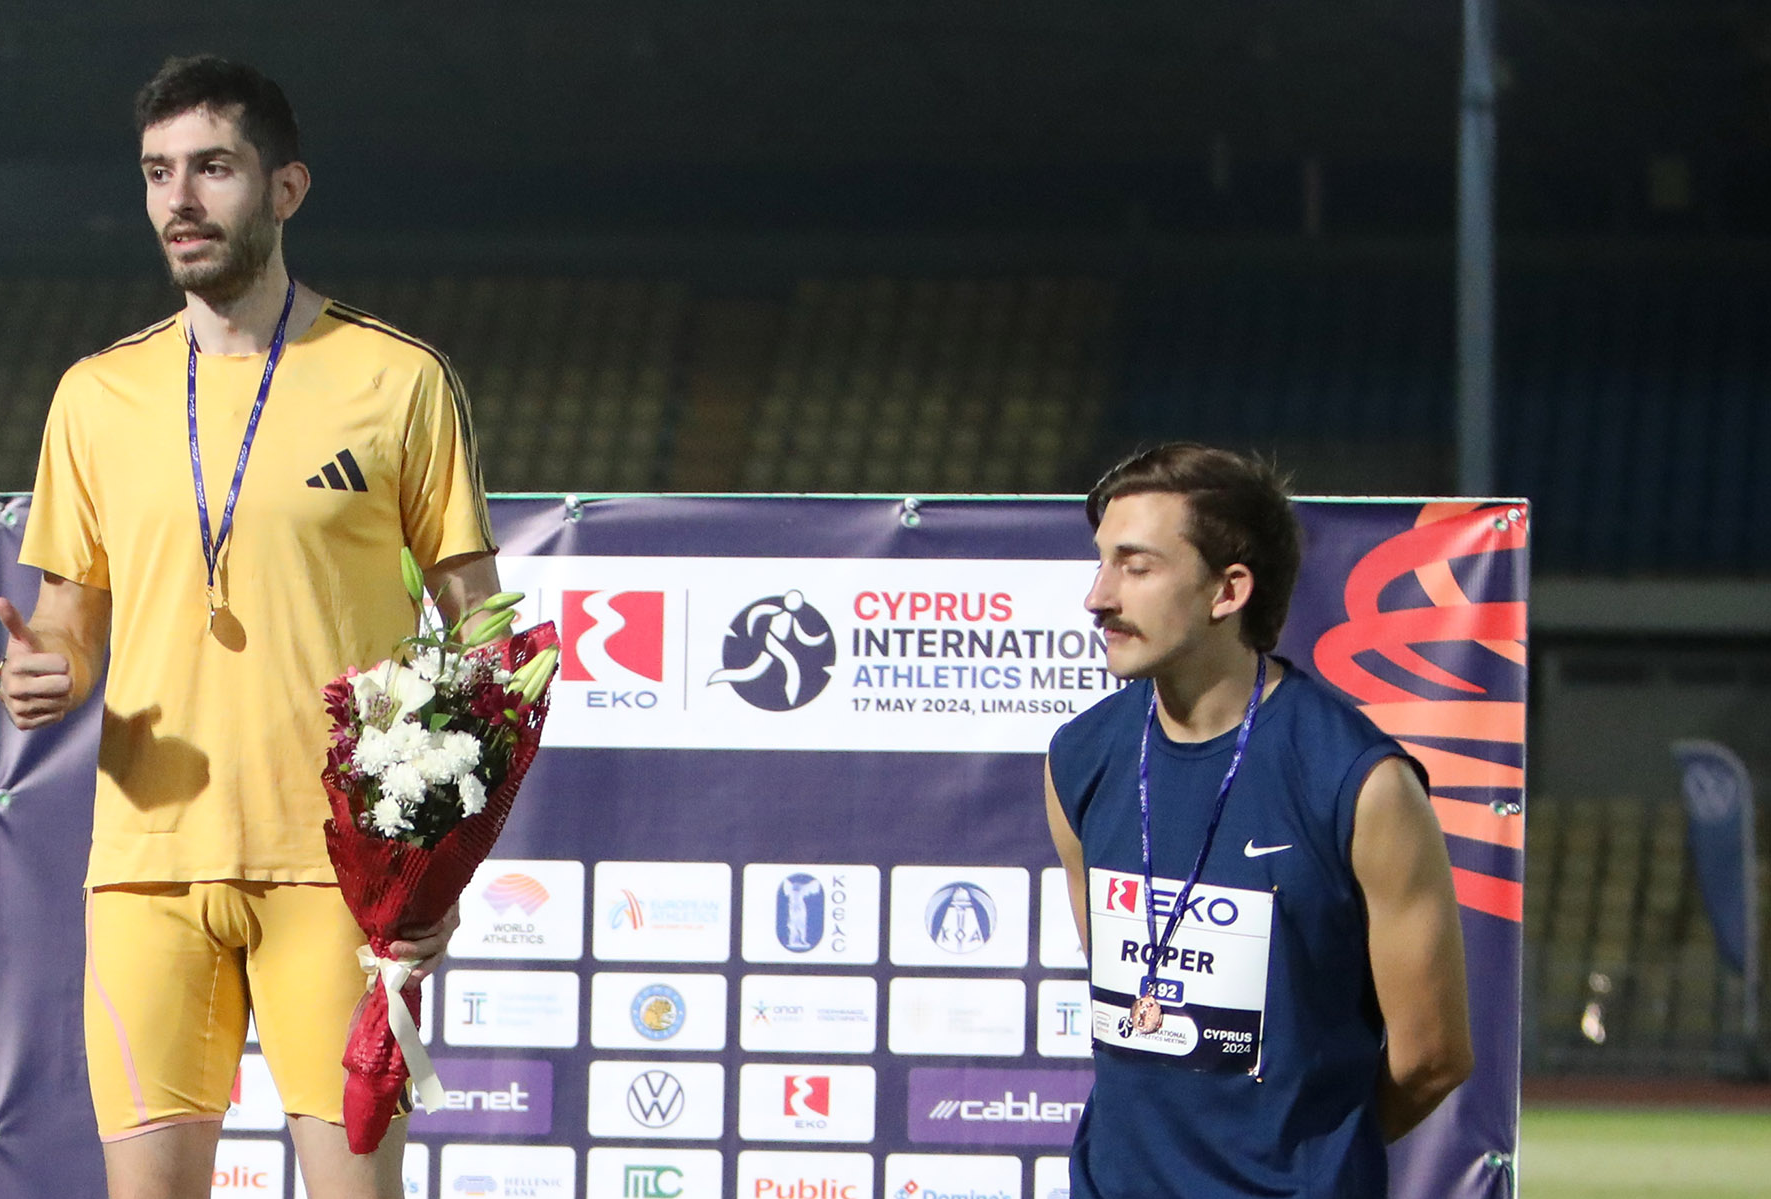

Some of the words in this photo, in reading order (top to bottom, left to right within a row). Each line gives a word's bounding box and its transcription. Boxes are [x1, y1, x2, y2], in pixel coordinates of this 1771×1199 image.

[853, 591, 1013, 622] CYPRUS
[852, 628, 1108, 659] INTERNATION
[852, 665, 1021, 690] ATHLETICS
[587, 690, 658, 709] EKO
[853, 698, 869, 712] 17
[876, 698, 917, 713] MAY
[924, 699, 976, 716] 2024,
[981, 700, 1077, 714] LIMASSOL
[1151, 888, 1239, 927] EKO
[492, 923, 535, 934] WORLD
[482, 933, 545, 945] ATHLETICS
[1120, 939, 1215, 975] ROPER
[1203, 1028, 1253, 1043] CYPRUS
[1221, 1042, 1251, 1054] 2024
[960, 1090, 1086, 1124] cablen
[795, 1120, 828, 1129] EKO
[211, 1165, 268, 1188] blic
[504, 1177, 563, 1188] HELLENIC
[504, 1187, 537, 1197] BANK
